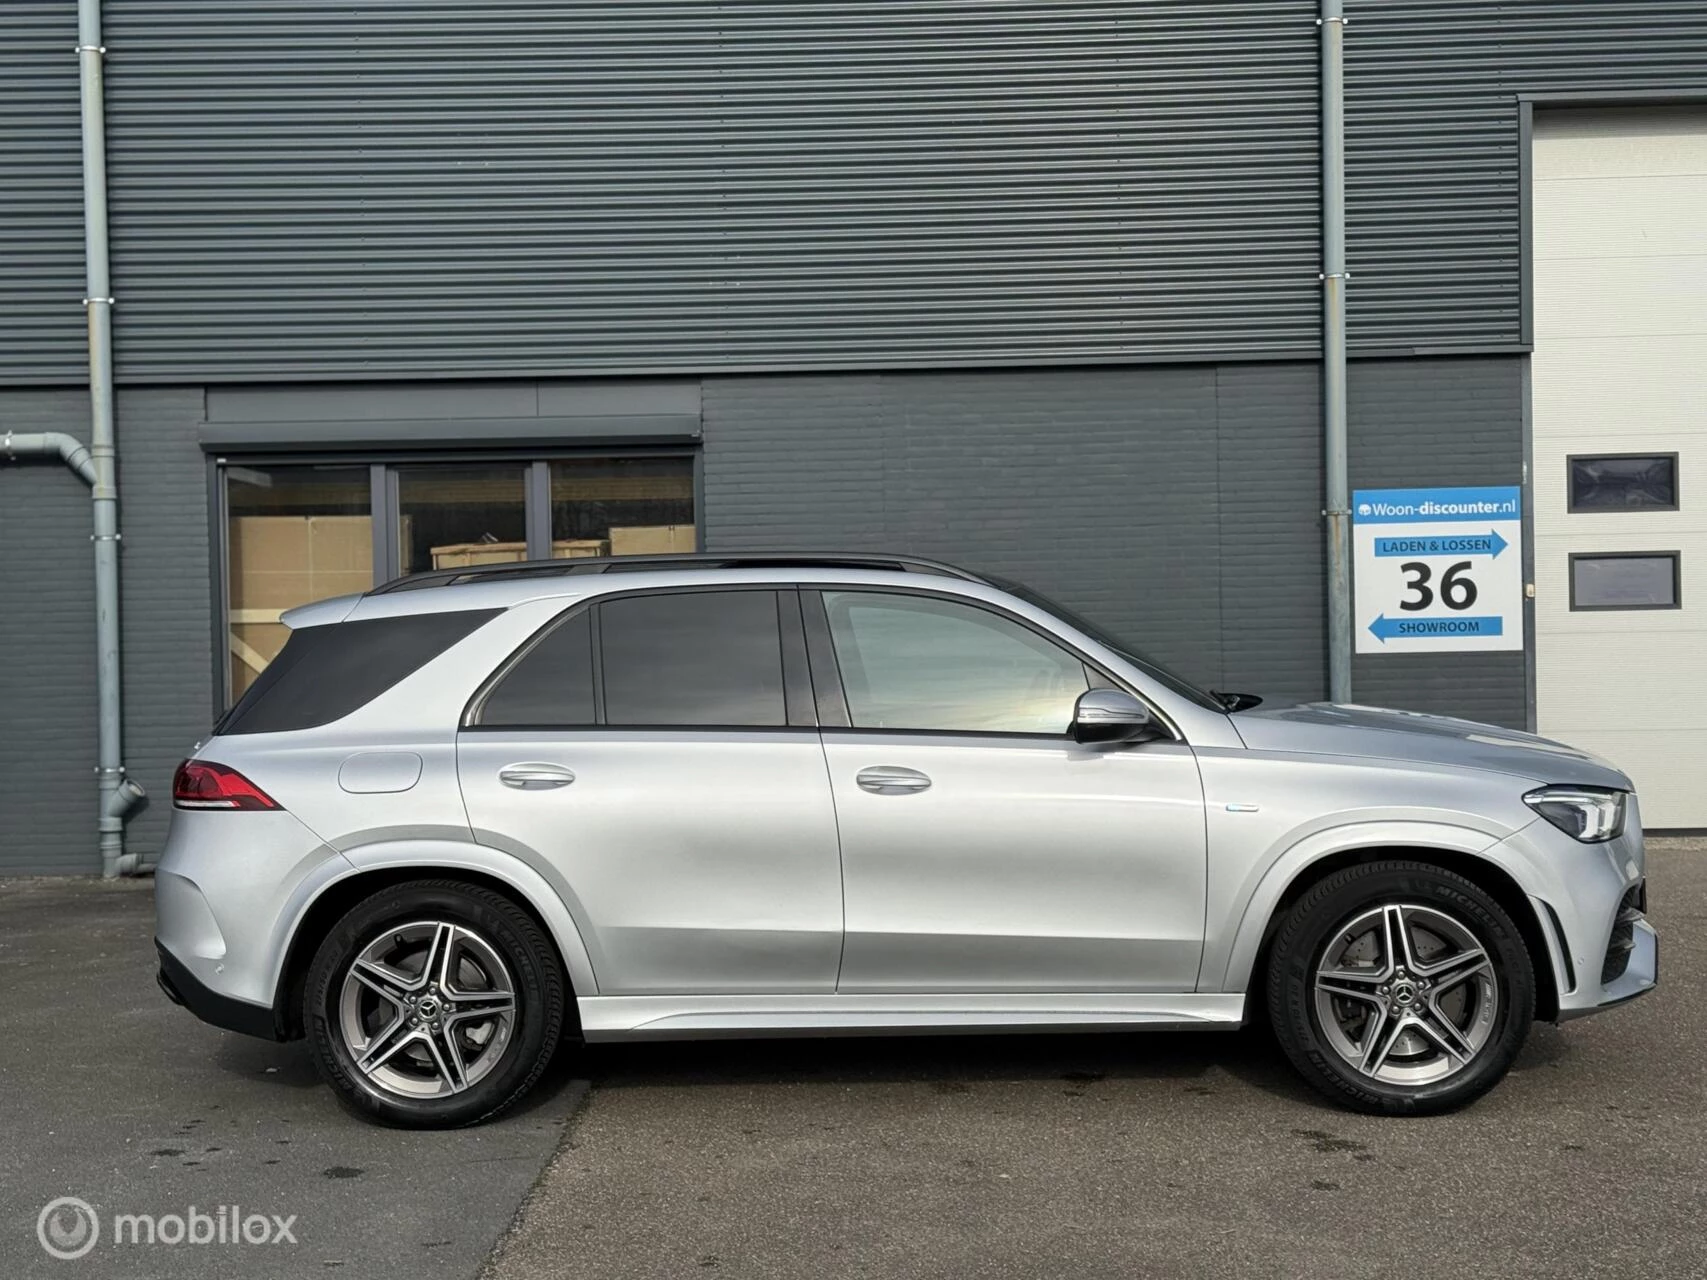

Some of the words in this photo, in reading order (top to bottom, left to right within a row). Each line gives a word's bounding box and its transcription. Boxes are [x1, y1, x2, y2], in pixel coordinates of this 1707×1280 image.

[1372, 499, 1516, 516] Woon-discounter.nl
[1383, 541, 1426, 553] LADEN
[1429, 540, 1440, 551] &
[1442, 539, 1491, 551] LOSSEN
[1400, 561, 1478, 611] 36
[1399, 621, 1480, 633] SHOWROOM
